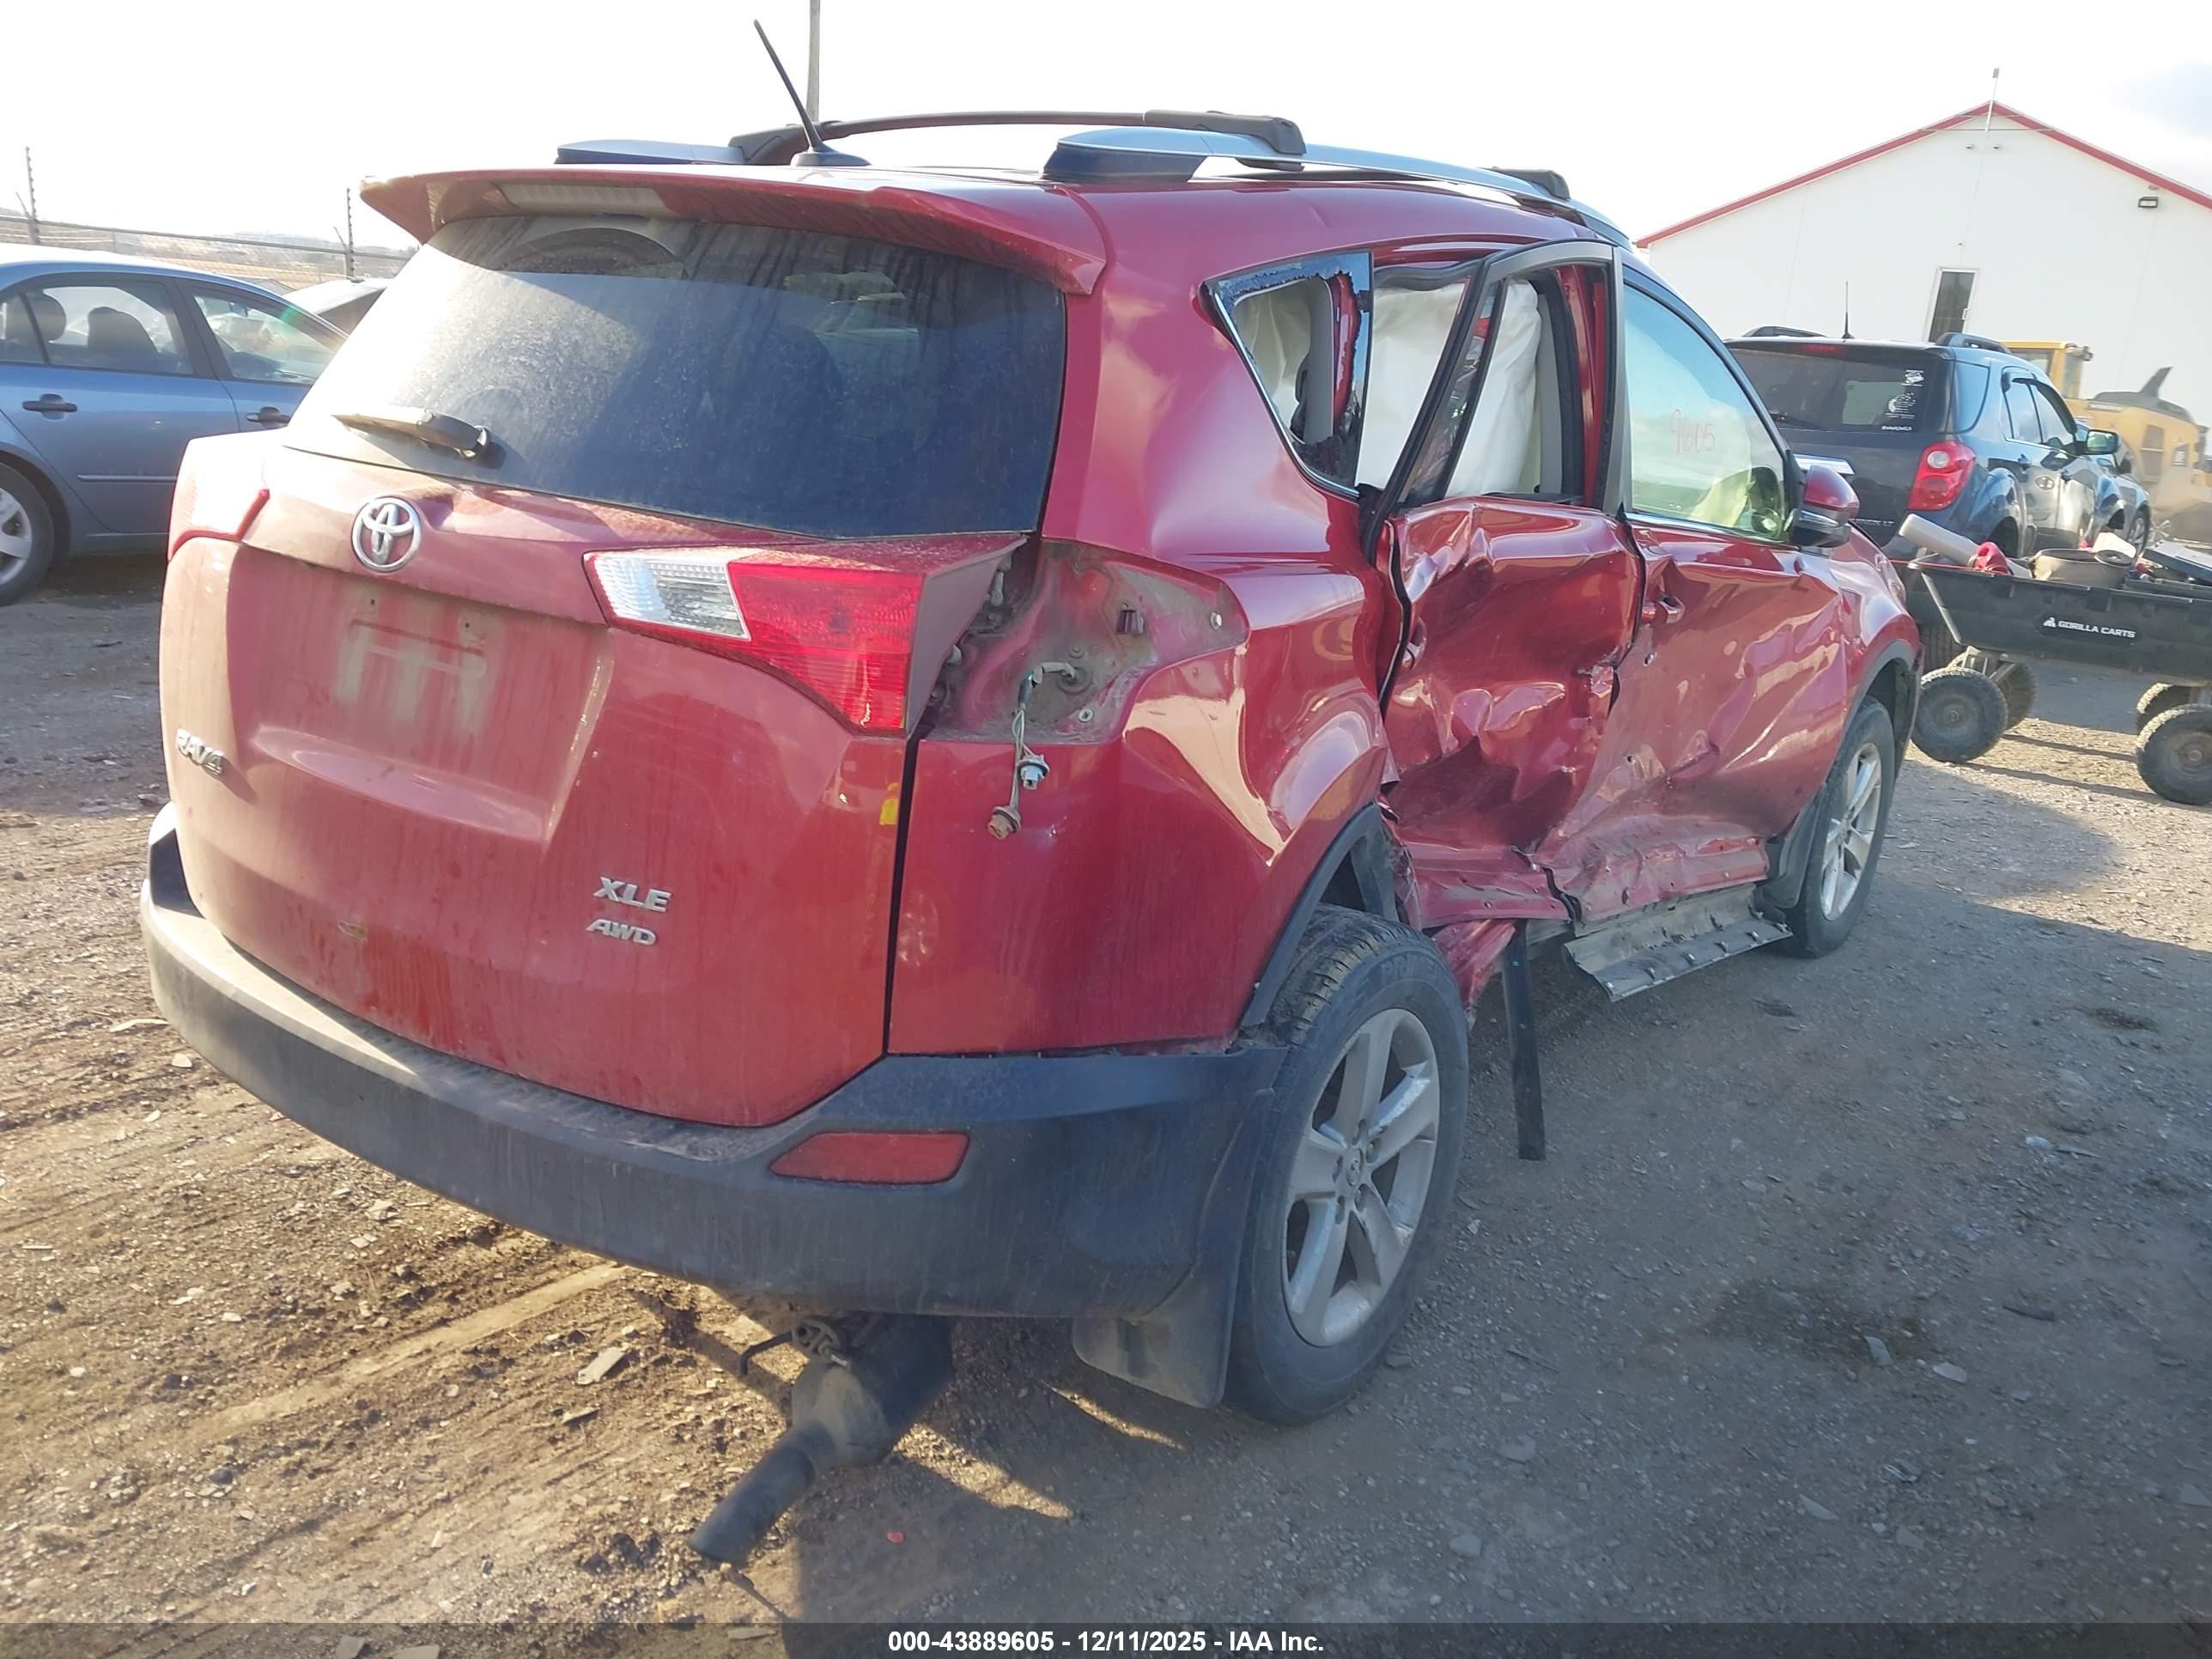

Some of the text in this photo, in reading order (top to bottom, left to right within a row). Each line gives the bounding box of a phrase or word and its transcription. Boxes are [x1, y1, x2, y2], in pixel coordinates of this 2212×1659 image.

[2058, 621, 2136, 638] GORILLA CARTS
[593, 877, 672, 912] XLE
[586, 919, 656, 945] AWD
